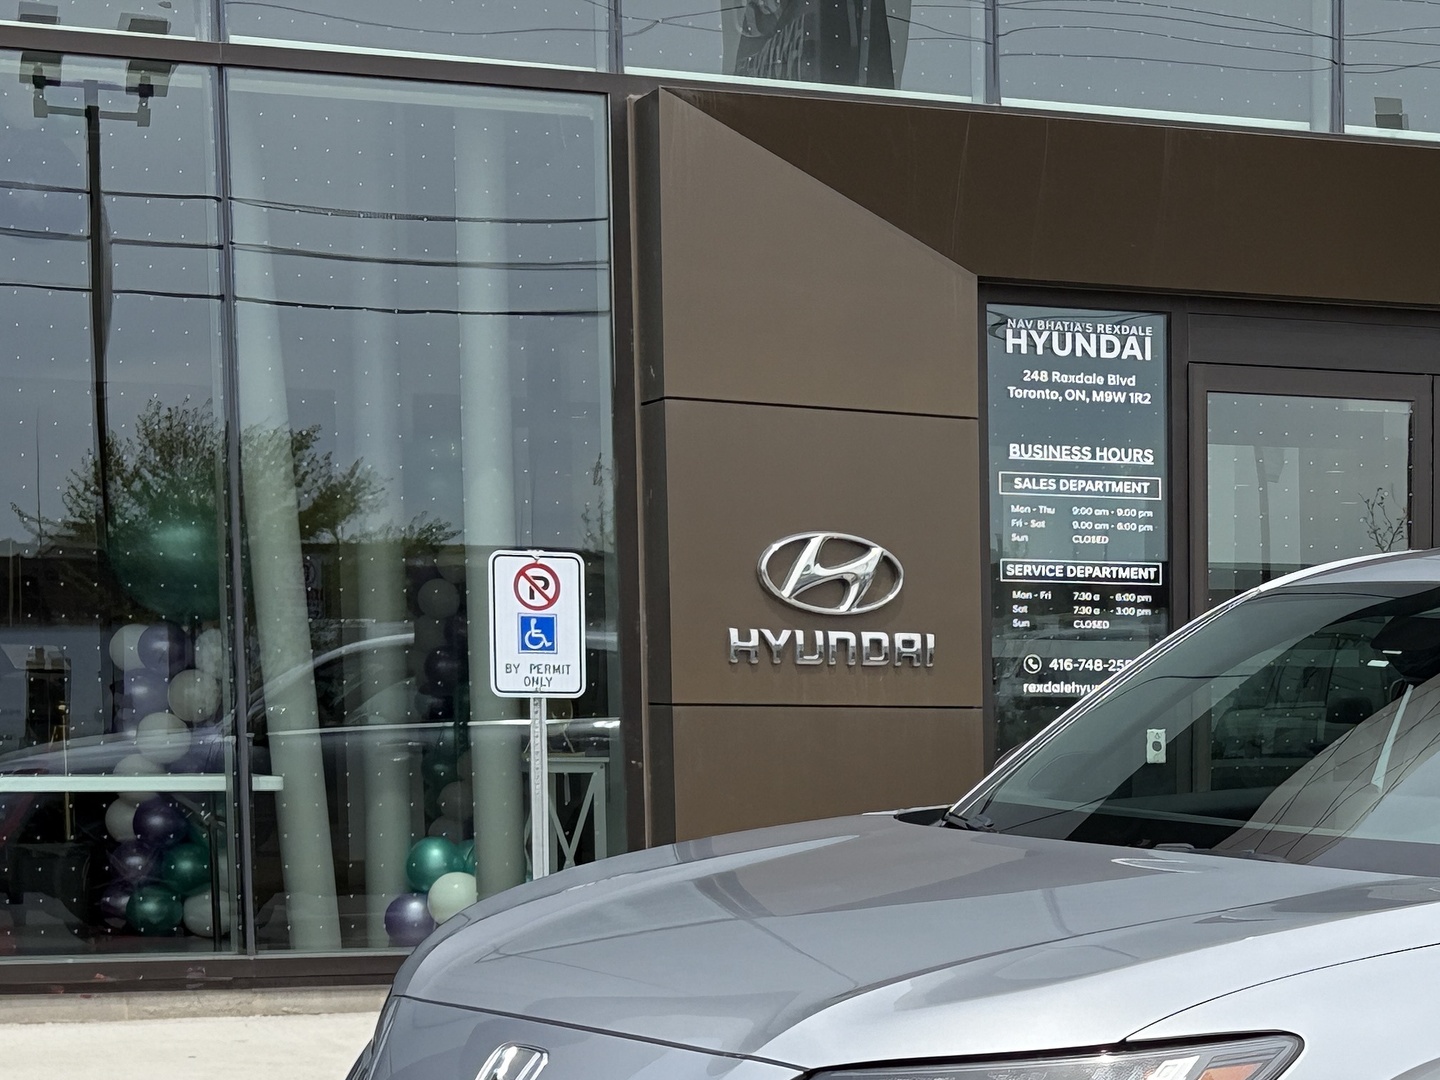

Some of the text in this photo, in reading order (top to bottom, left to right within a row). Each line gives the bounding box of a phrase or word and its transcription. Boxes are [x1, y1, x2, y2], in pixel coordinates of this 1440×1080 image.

[1007, 319, 1153, 336] NAV BHATIA'S REXDALE
[1005, 328, 1152, 361] HYUNDAI
[1022, 370, 1049, 382] 248
[1107, 374, 1136, 387] Blvd
[1007, 386, 1152, 404] Toronto, ON, M9W 1R2
[1009, 443, 1154, 463] BUSINESS HOURS
[1014, 477, 1150, 494] SALES DEPARTMENT
[1010, 504, 1031, 513] Mon
[1038, 505, 1056, 514] Thu
[1011, 518, 1023, 528] Fri
[1030, 518, 1046, 528] Sat
[1011, 532, 1109, 544] Sun CLOSED
[1006, 564, 1157, 580] SERVICE DEPARTMENT
[1012, 590, 1033, 600] Mon
[1039, 590, 1052, 600] Fri
[1012, 604, 1028, 614] Sat
[1012, 618, 1110, 629] Sun CLOSED
[728, 627, 935, 667] HYUNDAI
[505, 663, 571, 675] BY PERMIT
[1049, 658, 1132, 672] 416-748-25
[523, 675, 553, 688] ONLY
